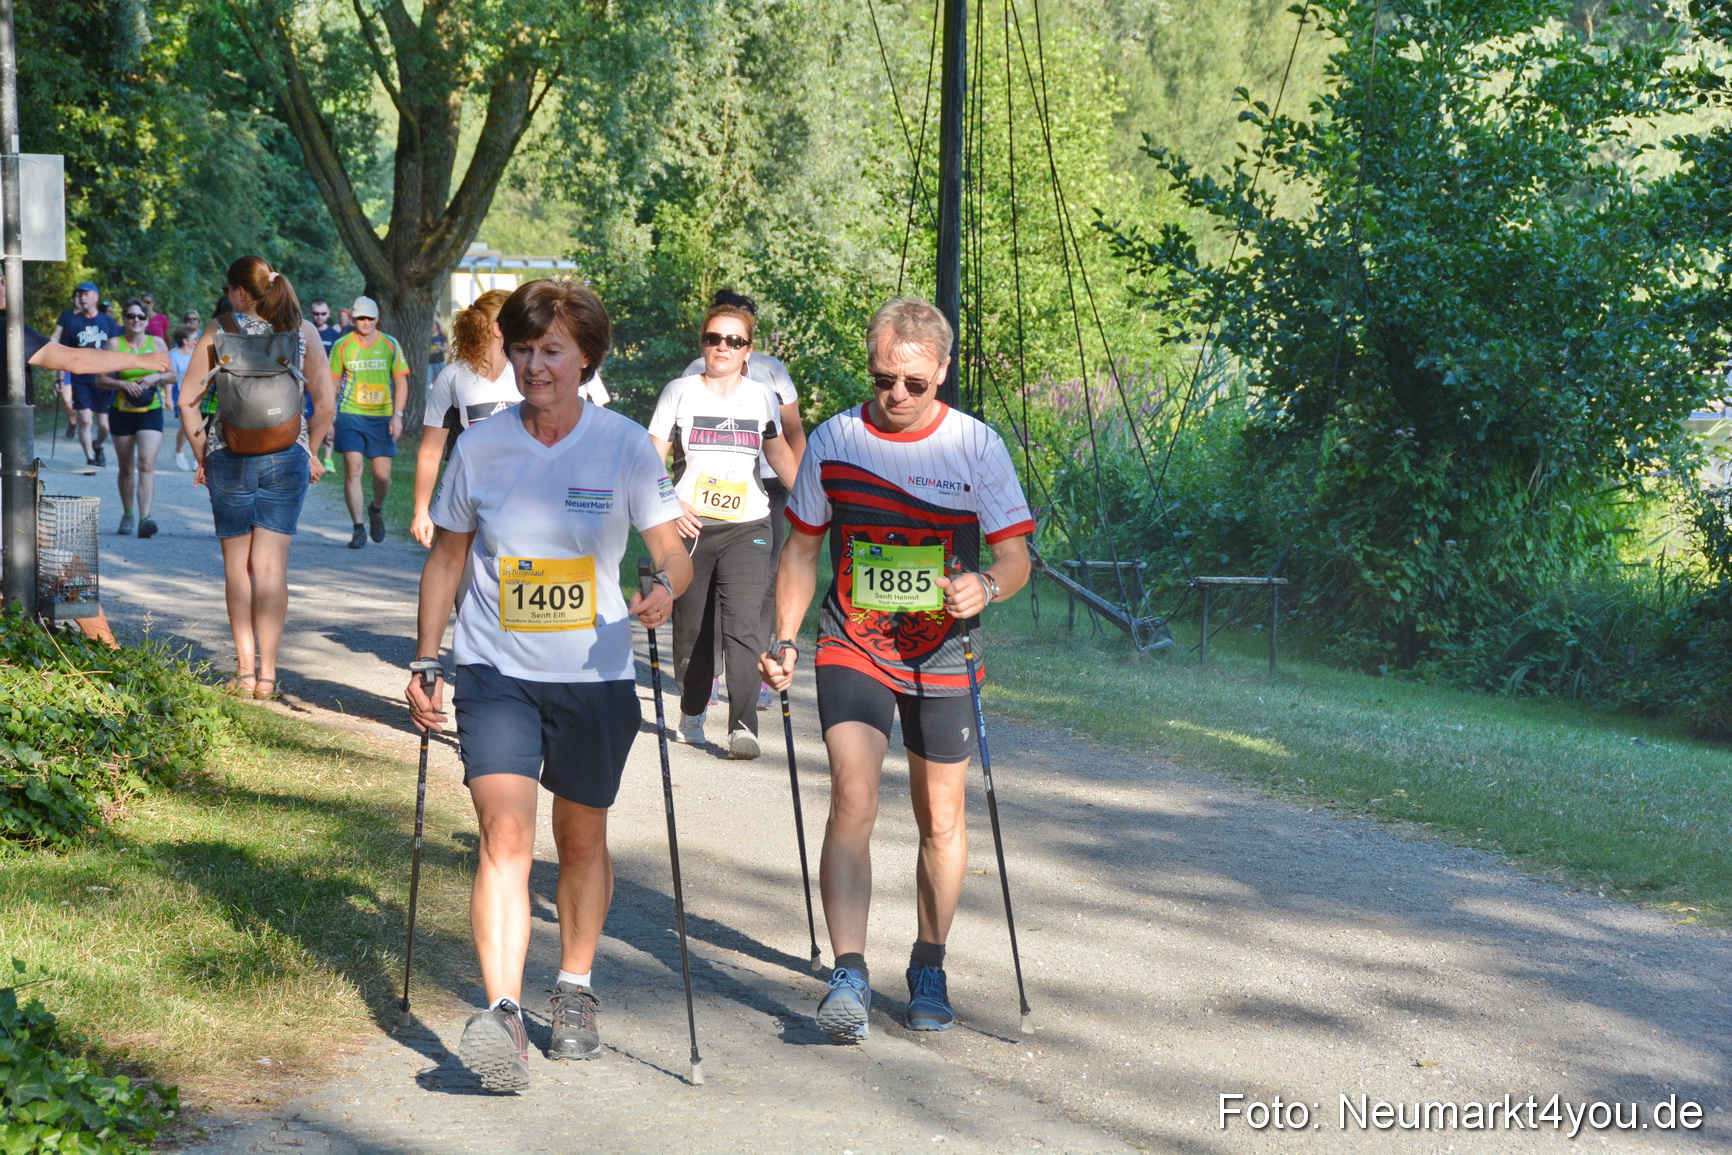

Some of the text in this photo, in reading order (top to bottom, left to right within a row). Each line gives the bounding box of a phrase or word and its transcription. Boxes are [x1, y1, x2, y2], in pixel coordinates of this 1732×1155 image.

[347, 360, 387, 370] BOCK
[362, 391, 379, 399] 218
[908, 475, 962, 491] NEUMARKT
[565, 499, 613, 509] NeuerMarkt
[702, 490, 741, 510] 1620
[864, 567, 931, 593] 1885
[512, 584, 584, 610] 1409
[874, 592, 893, 600] Senft
